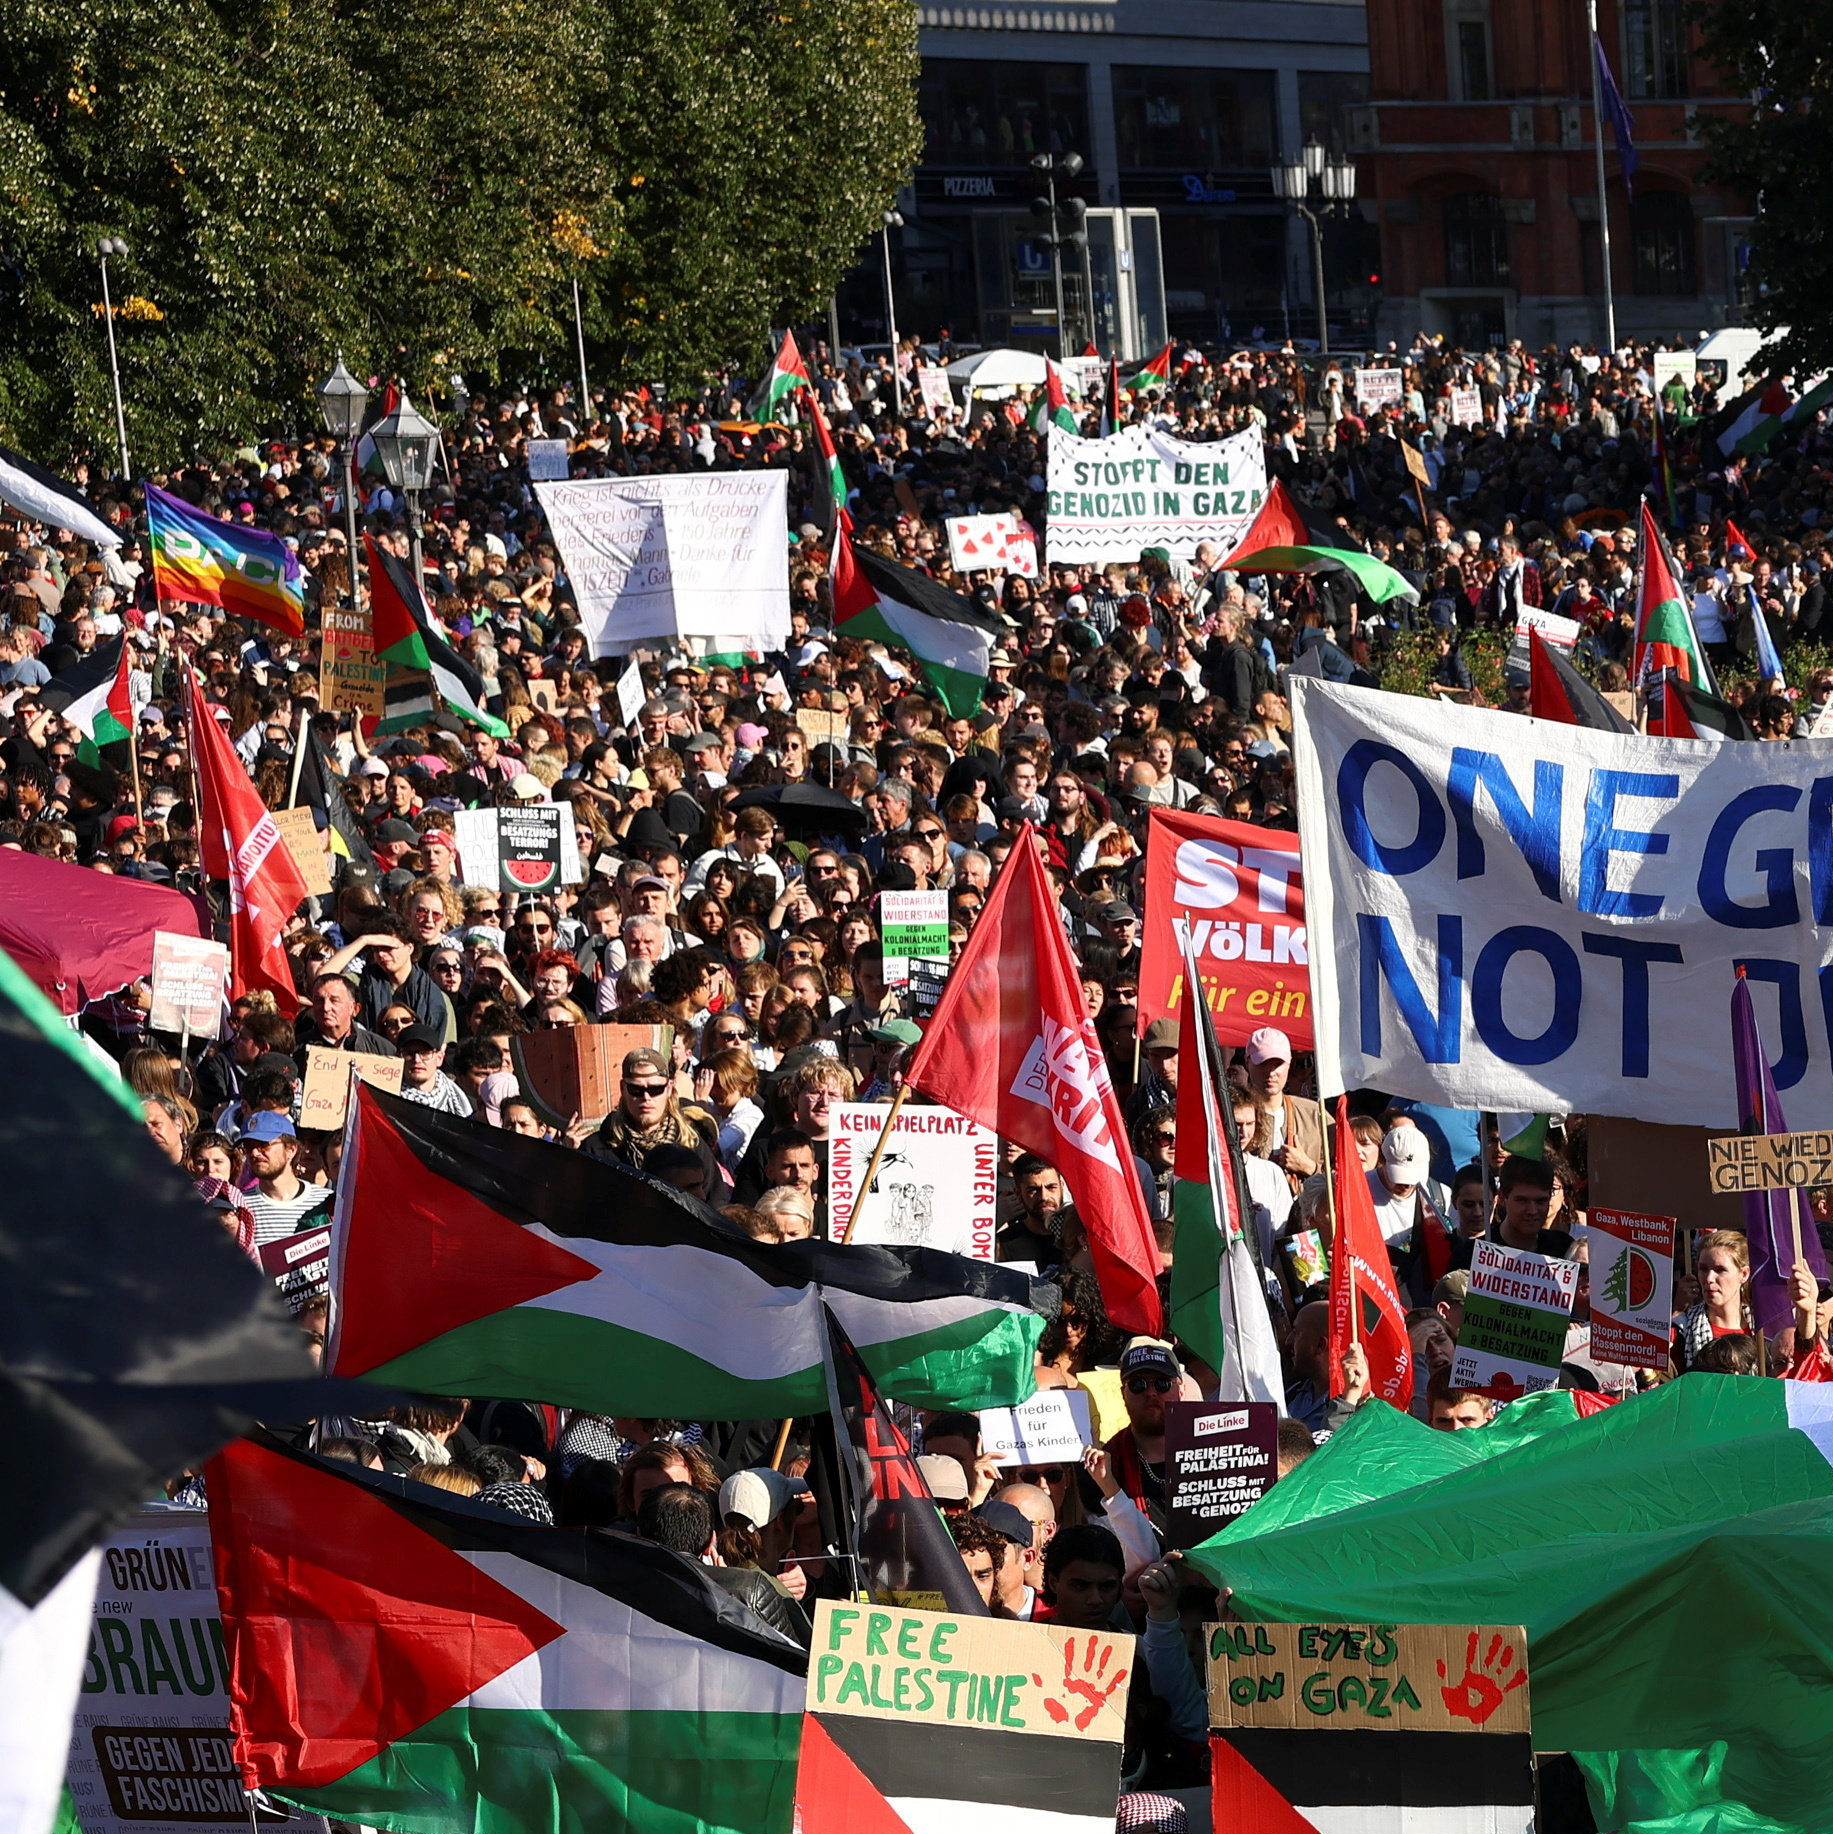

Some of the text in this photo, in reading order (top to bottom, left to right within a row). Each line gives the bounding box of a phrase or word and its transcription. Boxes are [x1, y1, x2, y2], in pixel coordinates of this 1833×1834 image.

[943, 176, 996, 197] PIZZERIA
[1074, 458, 1229, 486] STOPPT DEN
[684, 502, 759, 524] Aufgaben
[1047, 488, 1263, 518] GENOZID IN GAZA
[325, 613, 365, 631] FROM
[500, 807, 558, 821] SCHLUSS MIT
[501, 825, 558, 839] BESATZUNGS
[1336, 738, 1680, 918] ONE
[510, 838, 549, 849] TERROR!
[884, 908, 948, 922] WIDERSTAND
[884, 933, 947, 946] KOLONIALMACHT
[905, 924, 928, 934] GEGEN
[1245, 981, 1306, 1019] ein
[1357, 911, 1685, 1078] NOT
[313, 1054, 402, 1080] End Siege
[304, 1088, 334, 1111] Gaza
[839, 1112, 882, 1133] KEIN
[1710, 1139, 1759, 1163] NIE
[832, 1137, 853, 1199] KINDER
[974, 1143, 996, 1207] UNTER
[1595, 1211, 1671, 1234] Gaza, Westbank,
[289, 1237, 328, 1259] Die Linke
[1631, 1230, 1671, 1246] Libanon
[1478, 1249, 1572, 1285] SOLIDARITÄT &
[1472, 1270, 1572, 1310] WIDERSTAND
[1500, 1303, 1532, 1321] GEGEN
[1463, 1310, 1563, 1347] KOLONIALMACHT
[1592, 1322, 1622, 1341] Stoppt
[1624, 1328, 1645, 1342] den
[1129, 1347, 1149, 1359] FREE
[1480, 1336, 1549, 1363] BESATZUNG
[1591, 1335, 1657, 1357] Massenmord!
[1608, 1351, 1629, 1362] Waffen
[1128, 1354, 1167, 1366] PALESTINE
[1457, 1357, 1478, 1369] JETZT
[1455, 1367, 1476, 1379] AKTIV
[1010, 1402, 1062, 1416] Frieden
[1027, 1419, 1047, 1433] für
[1199, 1415, 1246, 1432] Die Linke
[995, 1434, 1083, 1451] Gazas Kinder!
[1175, 1443, 1260, 1463] FREIHEIT FÜR
[1180, 1453, 1270, 1475] PALÄSTINA!
[1177, 1475, 1267, 1495] SCHLUSS MIT
[1172, 1487, 1263, 1509] BESATZUNG
[102, 1600, 133, 1615] new
[828, 1608, 960, 1667] FREE
[1208, 1624, 1398, 1667] ALL EYES
[814, 1650, 1030, 1729] PALESTINE
[1227, 1671, 1423, 1720] ON GAZA
